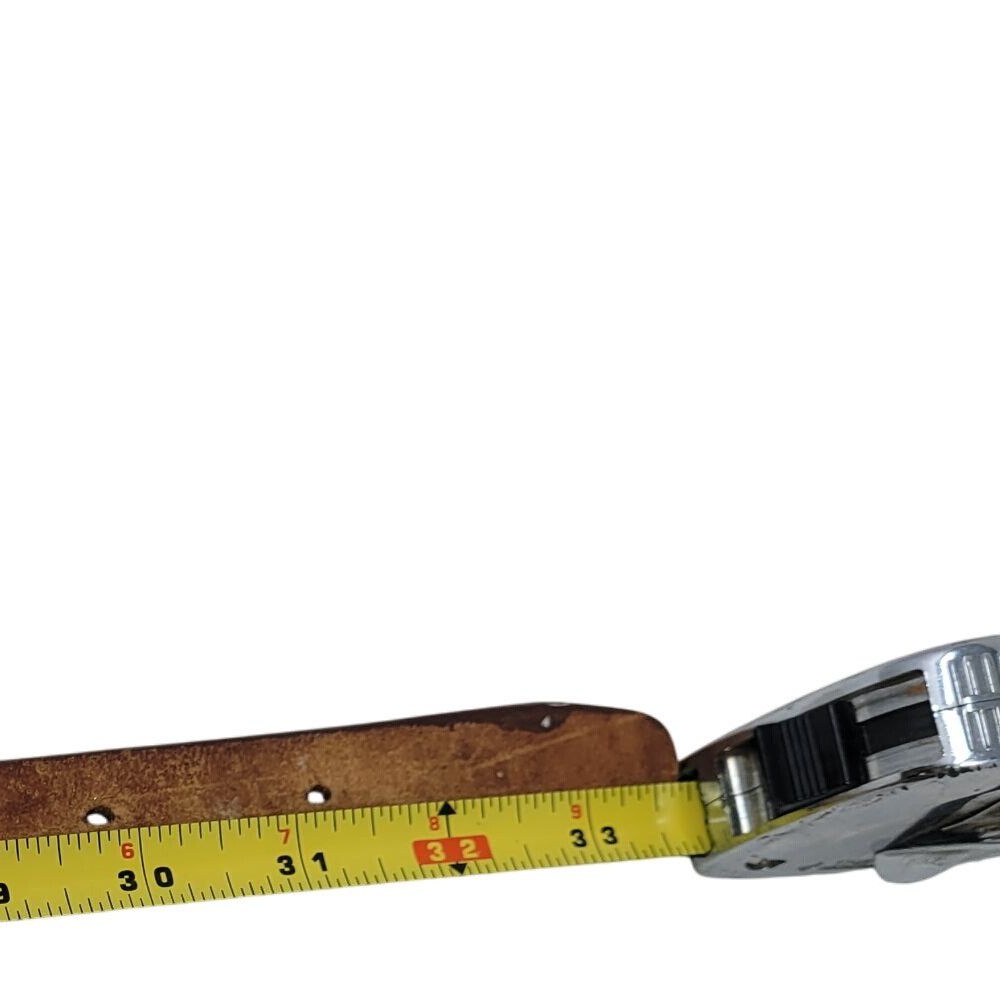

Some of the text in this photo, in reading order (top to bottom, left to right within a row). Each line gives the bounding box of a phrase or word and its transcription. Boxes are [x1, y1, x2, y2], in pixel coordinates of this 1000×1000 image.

[121, 842, 135, 859] 6
[279, 828, 291, 845] 7
[429, 816, 440, 831] 8
[571, 805, 582, 820] 9
